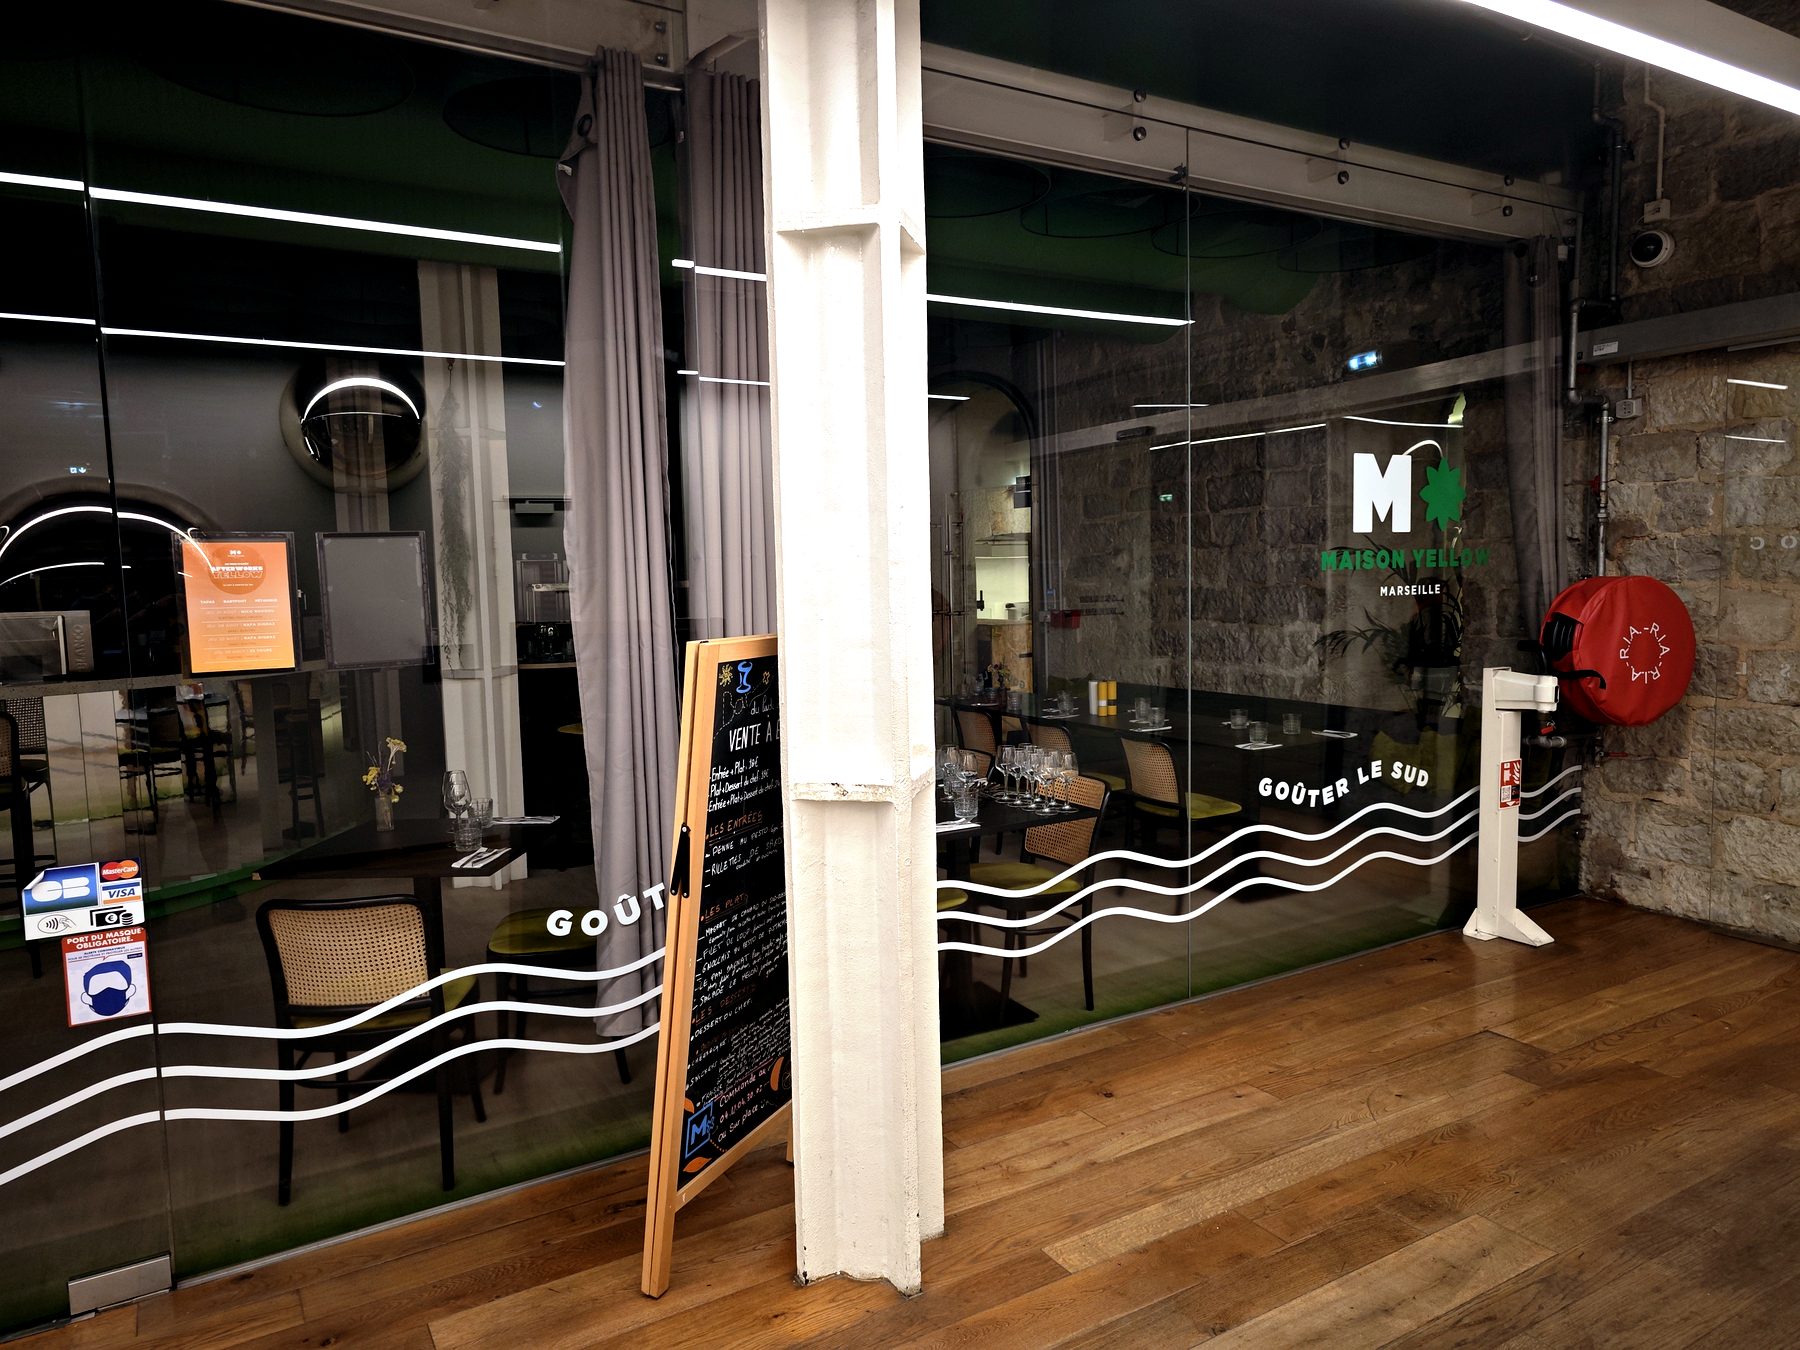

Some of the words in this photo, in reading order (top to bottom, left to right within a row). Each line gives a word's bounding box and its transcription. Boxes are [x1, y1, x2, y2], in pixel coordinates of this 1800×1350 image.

[1352, 452, 1412, 533] M
[1319, 548, 1405, 572] MAISON
[1411, 547, 1491, 569] YELLOW
[1379, 583, 1442, 597] MARSEILLE
[729, 723, 762, 752] VENTE
[711, 765, 730, 782] Entrée
[725, 775, 743, 793] Dessert
[1258, 777, 1350, 808] GOÛTER
[1356, 760, 1383, 785] LE
[1390, 761, 1430, 788] SUD
[709, 822, 725, 838] LES
[727, 810, 763, 832] ENTRÉES
[101, 865, 139, 877] MasterCard
[108, 887, 136, 899] VISA
[546, 881, 666, 937] GOÛT
[704, 904, 721, 919] LES
[66, 936, 89, 945] PORT
[91, 933, 104, 941] DU
[694, 1015, 723, 1038] DESSERT
